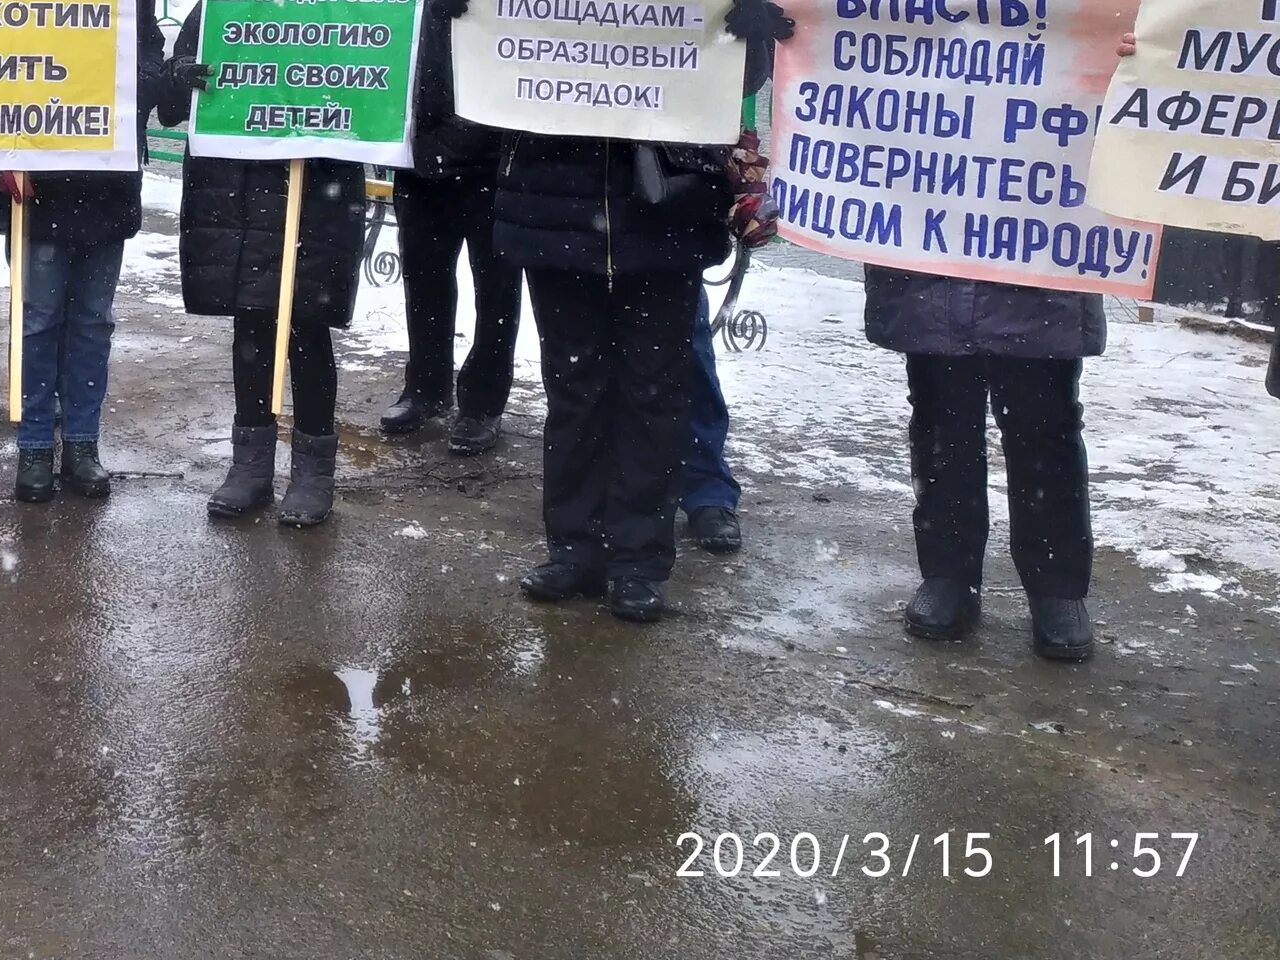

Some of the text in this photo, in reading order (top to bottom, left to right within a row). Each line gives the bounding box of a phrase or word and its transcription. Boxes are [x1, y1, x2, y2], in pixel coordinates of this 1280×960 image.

[224, 22, 391, 47] ЭКОЛОГИЮ
[497, 37, 698, 69] ОБРАЗЦОВЫЙ
[217, 63, 389, 89] ДЛЯ СВОИХ
[833, 31, 1046, 86] СОБЛЮДАЙ
[517, 78, 661, 108] ПОРЯДОК!
[795, 81, 975, 139] ЗАКОНЫ
[246, 102, 351, 130] ДЕТЕЙ!
[789, 133, 1087, 208] ПОВЕРНИТЕСЬ
[1158, 152, 1207, 195] И
[772, 177, 1153, 280] ЛИЦОМ К НАРОДУ!
